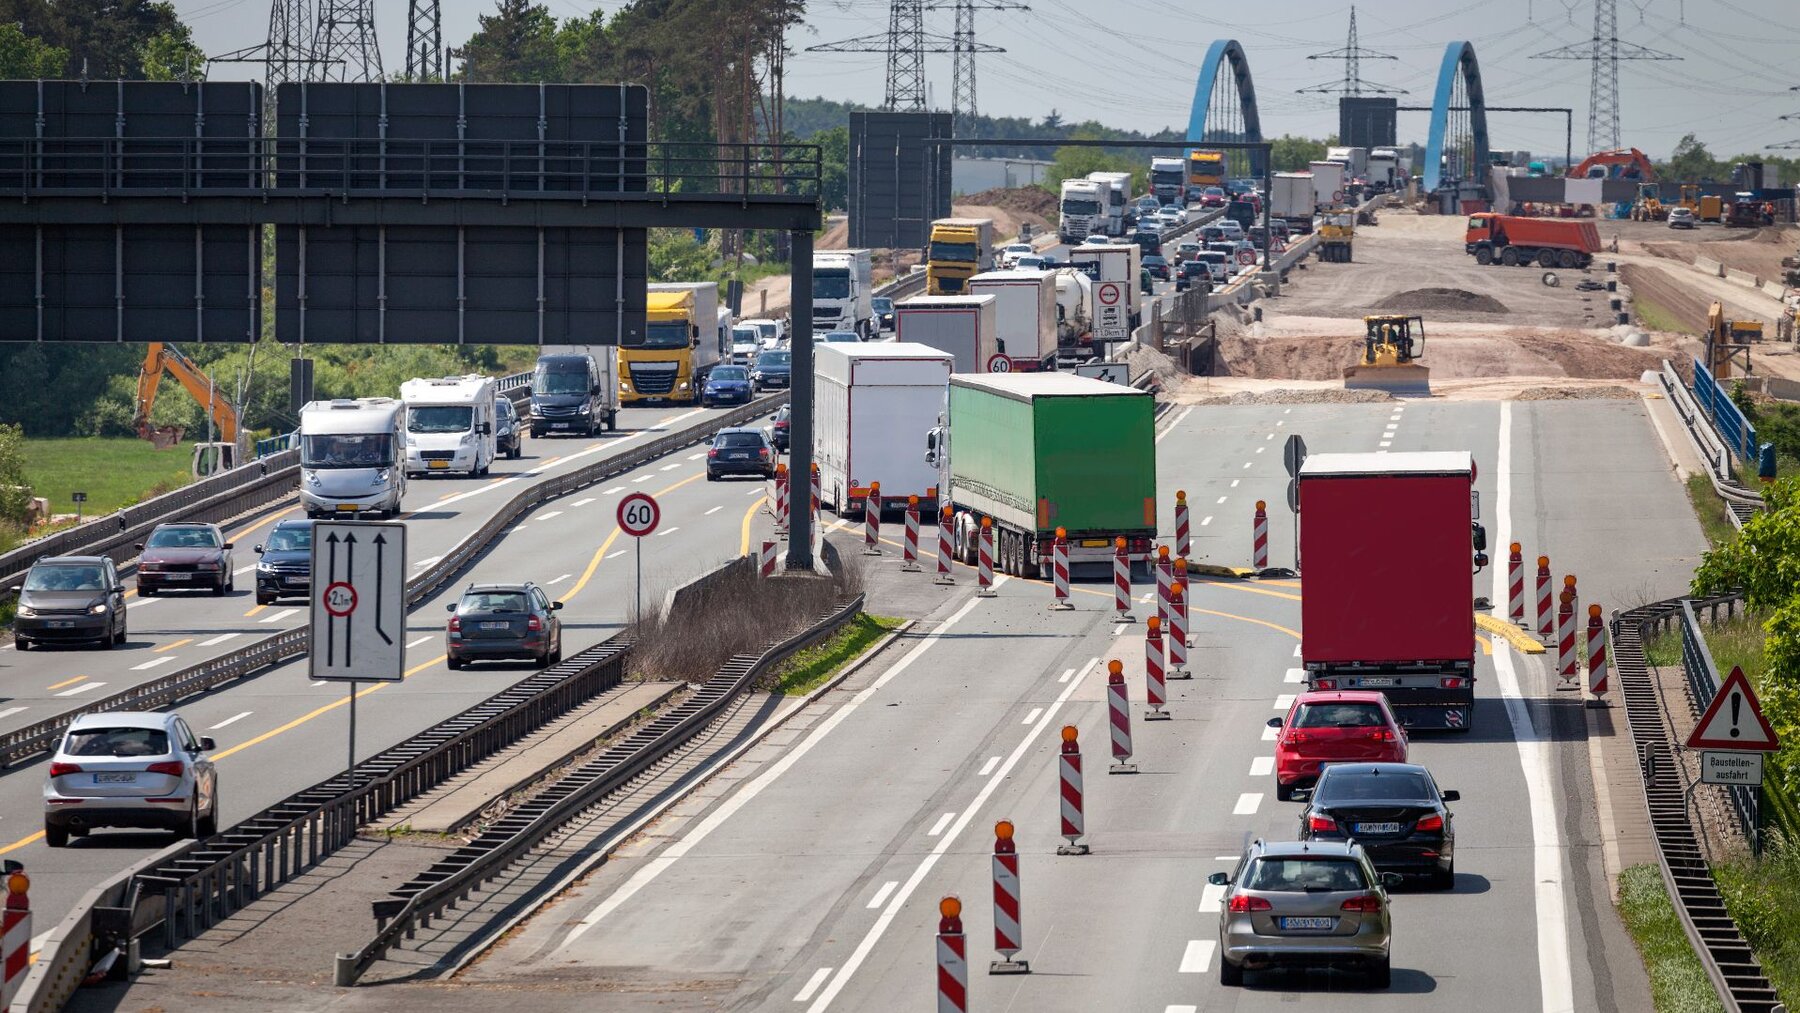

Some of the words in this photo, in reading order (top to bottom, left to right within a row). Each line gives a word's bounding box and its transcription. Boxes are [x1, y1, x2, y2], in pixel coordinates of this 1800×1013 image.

[993, 361, 1008, 373] 60
[626, 505, 651, 525] 60
[1710, 757, 1755, 767] Baustellen-
[1715, 771, 1749, 780] ausfahrt
